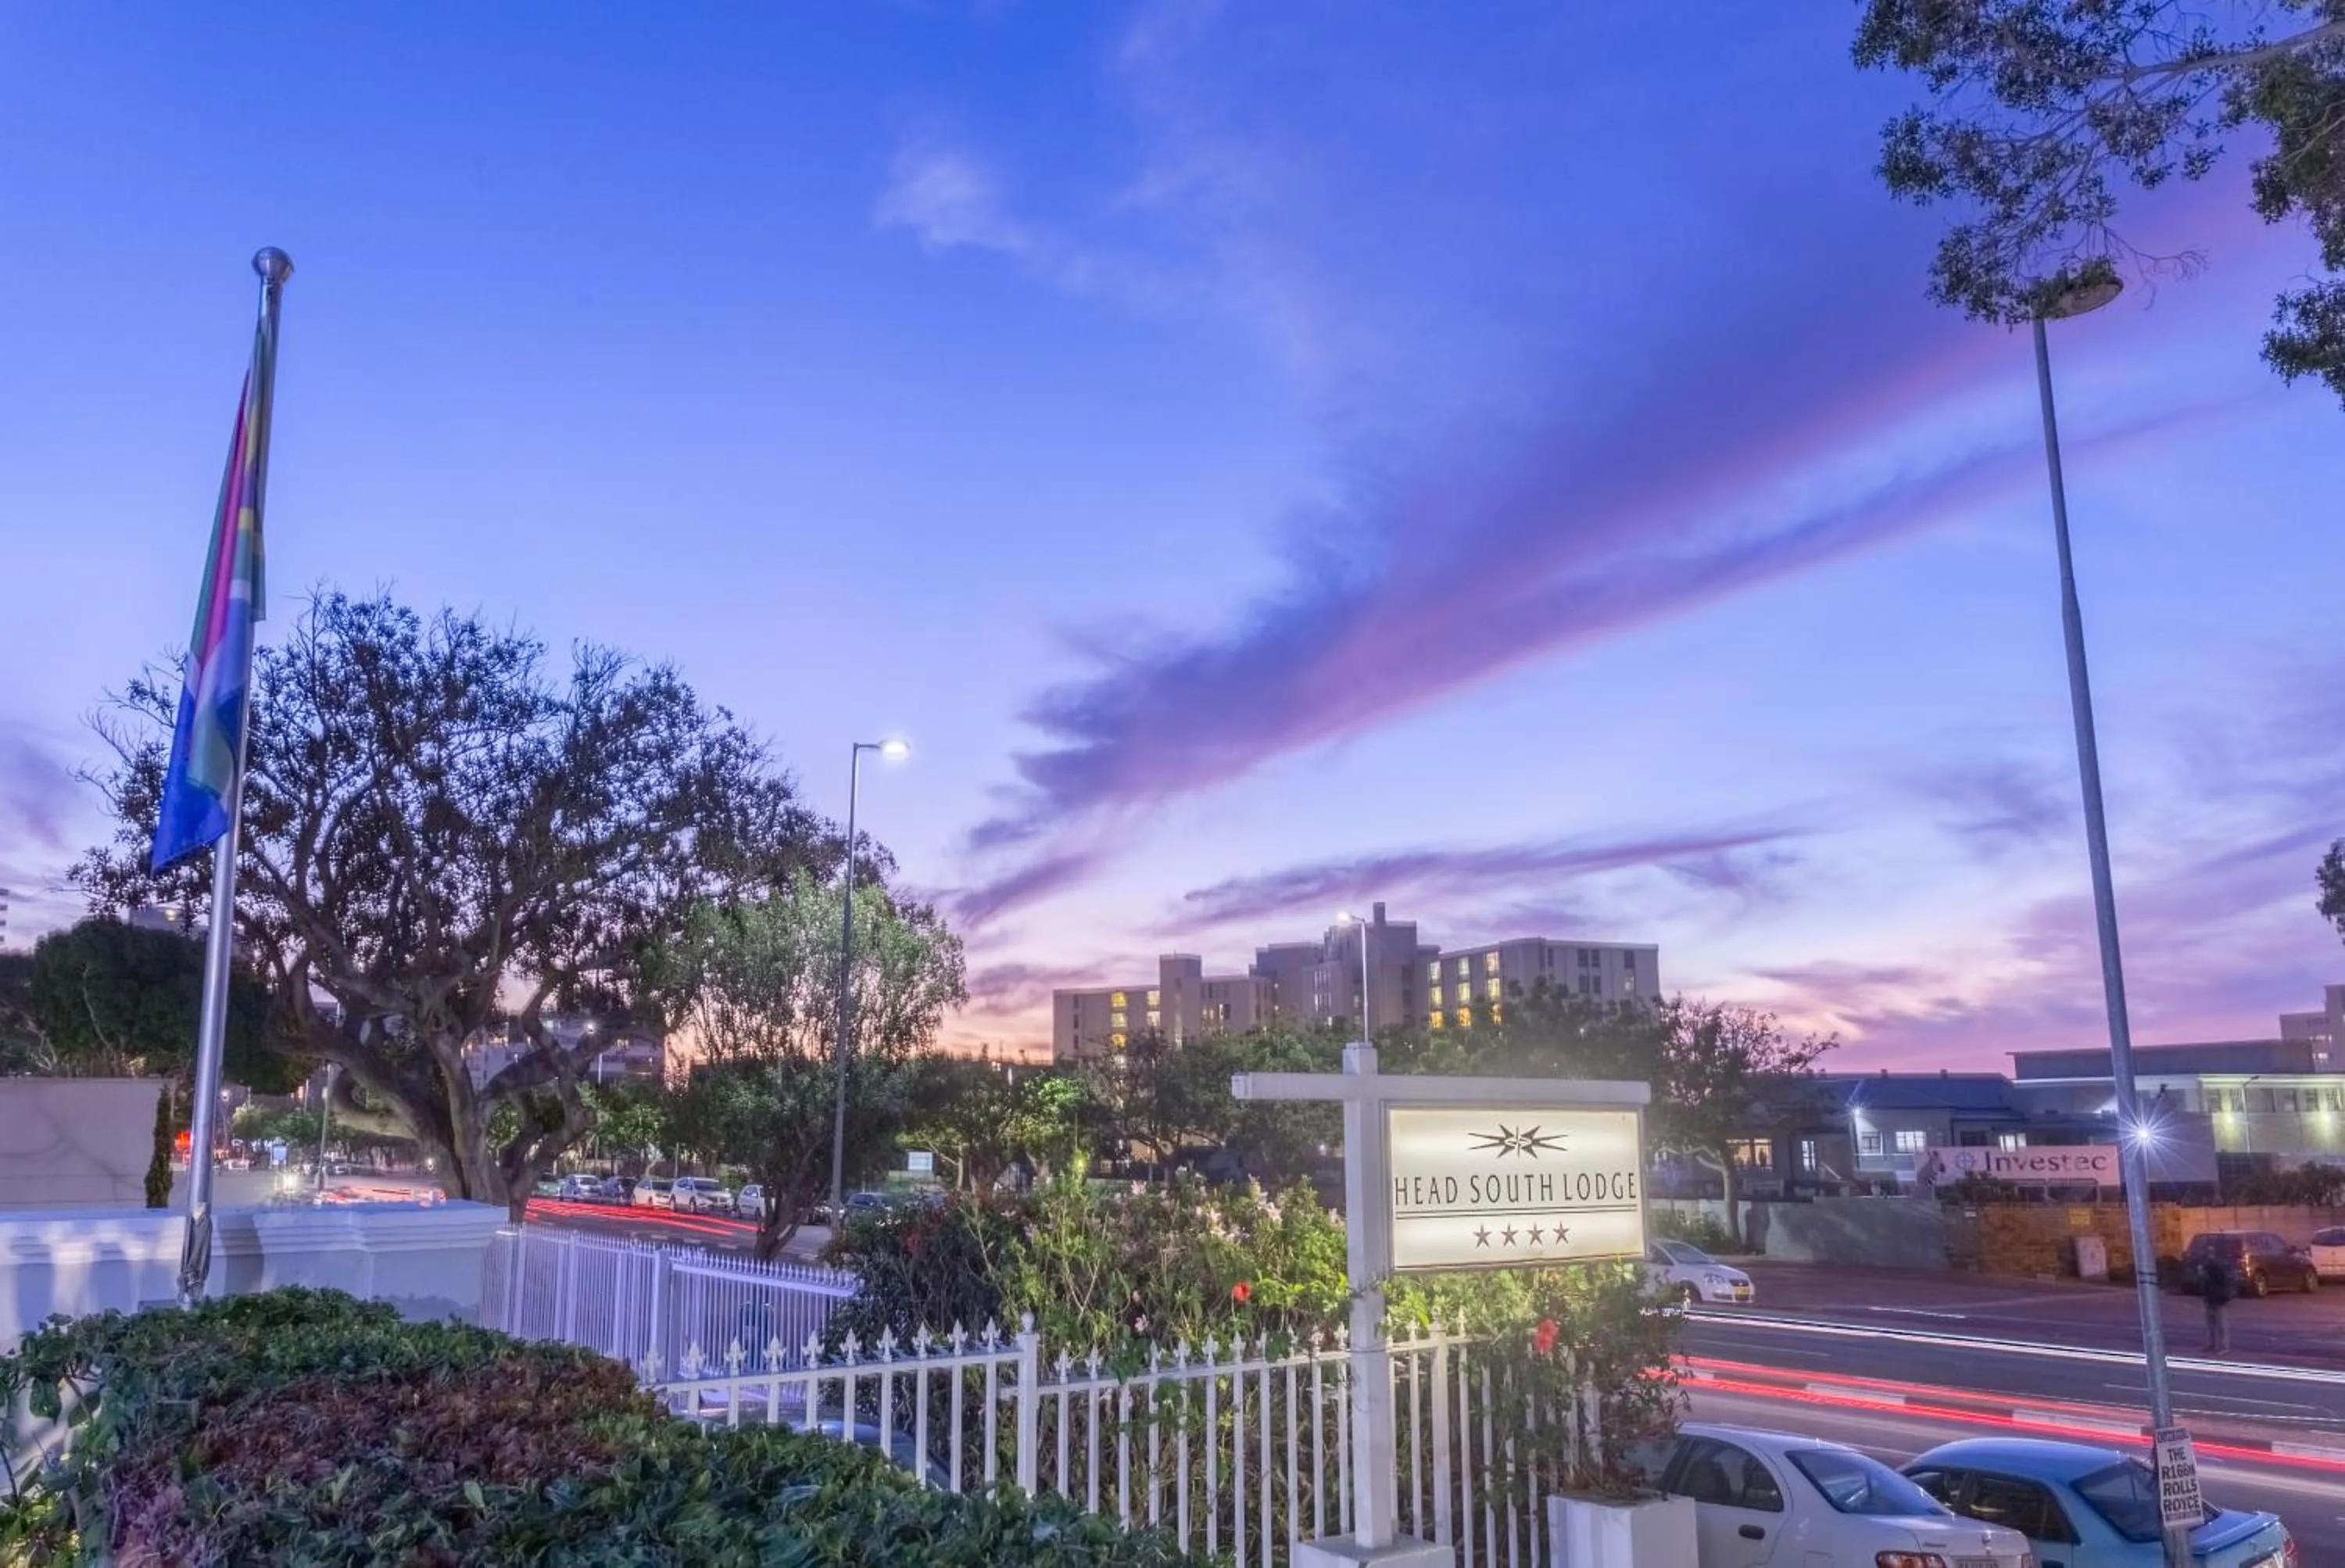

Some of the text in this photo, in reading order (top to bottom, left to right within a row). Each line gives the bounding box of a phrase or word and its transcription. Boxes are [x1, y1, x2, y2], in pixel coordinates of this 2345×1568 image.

[1985, 1151, 2107, 1172] Investec
[1395, 1172, 1637, 1205] HEAD SOUTH LODGE
[2167, 1446, 2187, 1461] THE
[2163, 1479, 2197, 1497] ROLLS
[2163, 1494, 2200, 1513] ROYCE
